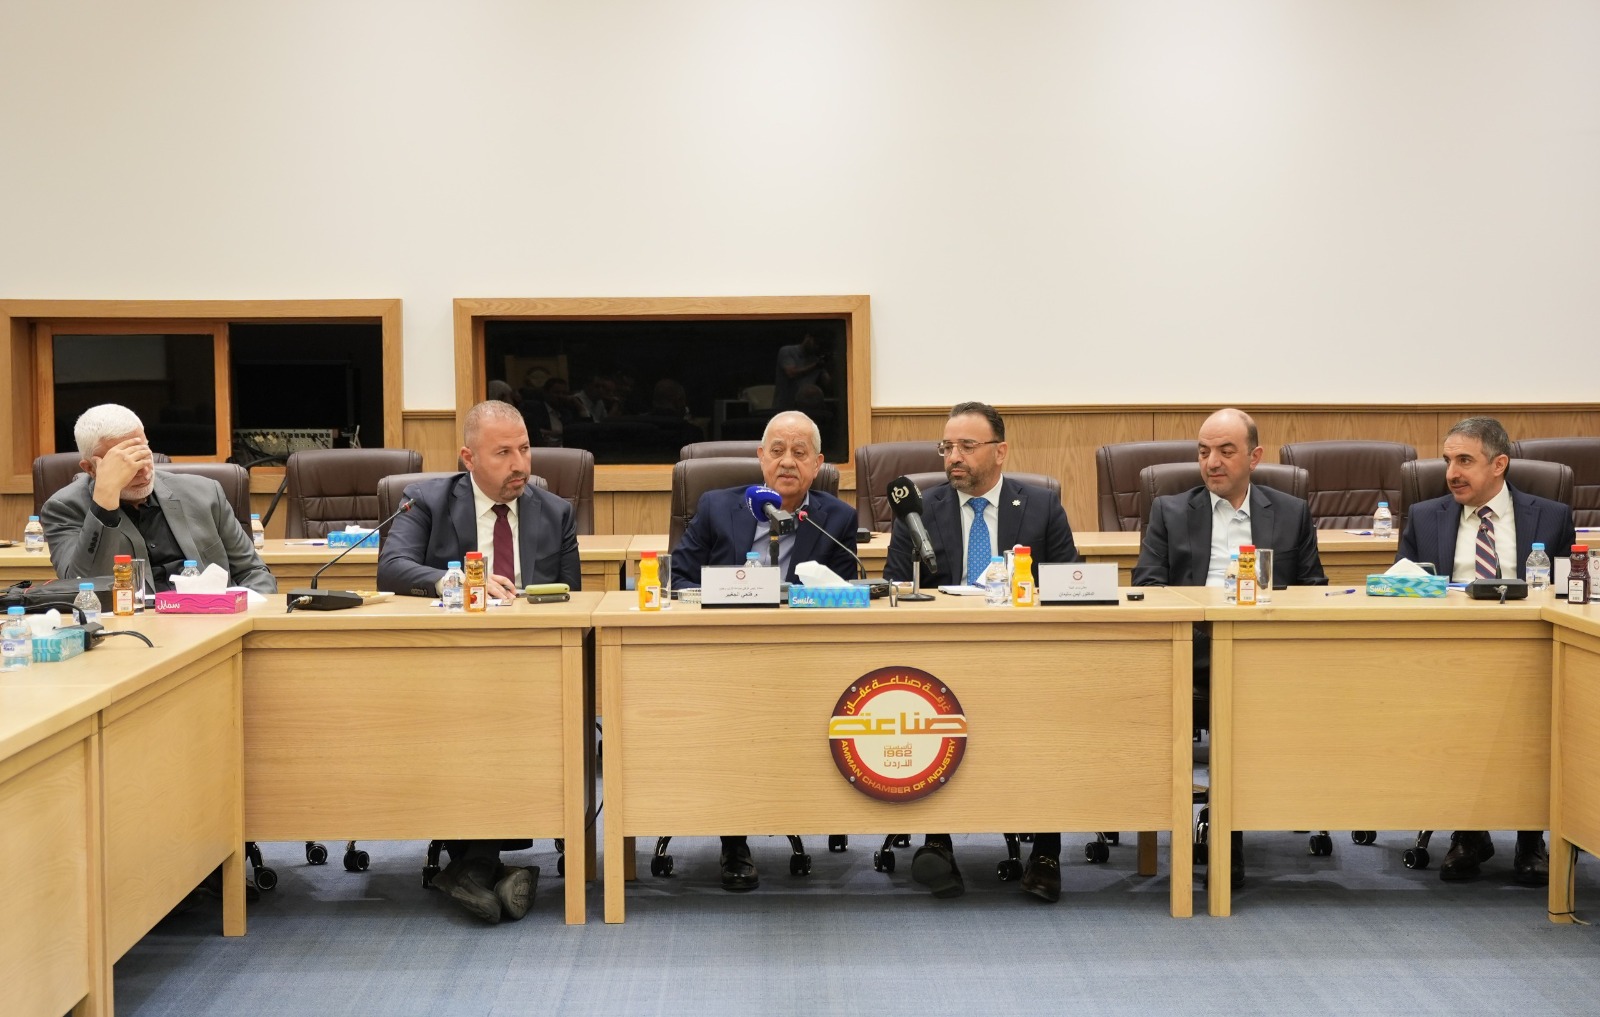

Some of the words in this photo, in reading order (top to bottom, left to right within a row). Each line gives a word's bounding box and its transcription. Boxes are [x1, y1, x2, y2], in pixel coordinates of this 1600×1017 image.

[872, 675, 922, 689] صناعة
[922, 683, 952, 712] غرفة
[883, 749, 912, 757] 1962
[841, 740, 862, 777] AMMAN
[862, 776, 911, 794] CHAMBER
[913, 781, 926, 791] OF
[927, 739, 956, 783] INDUSTRY
